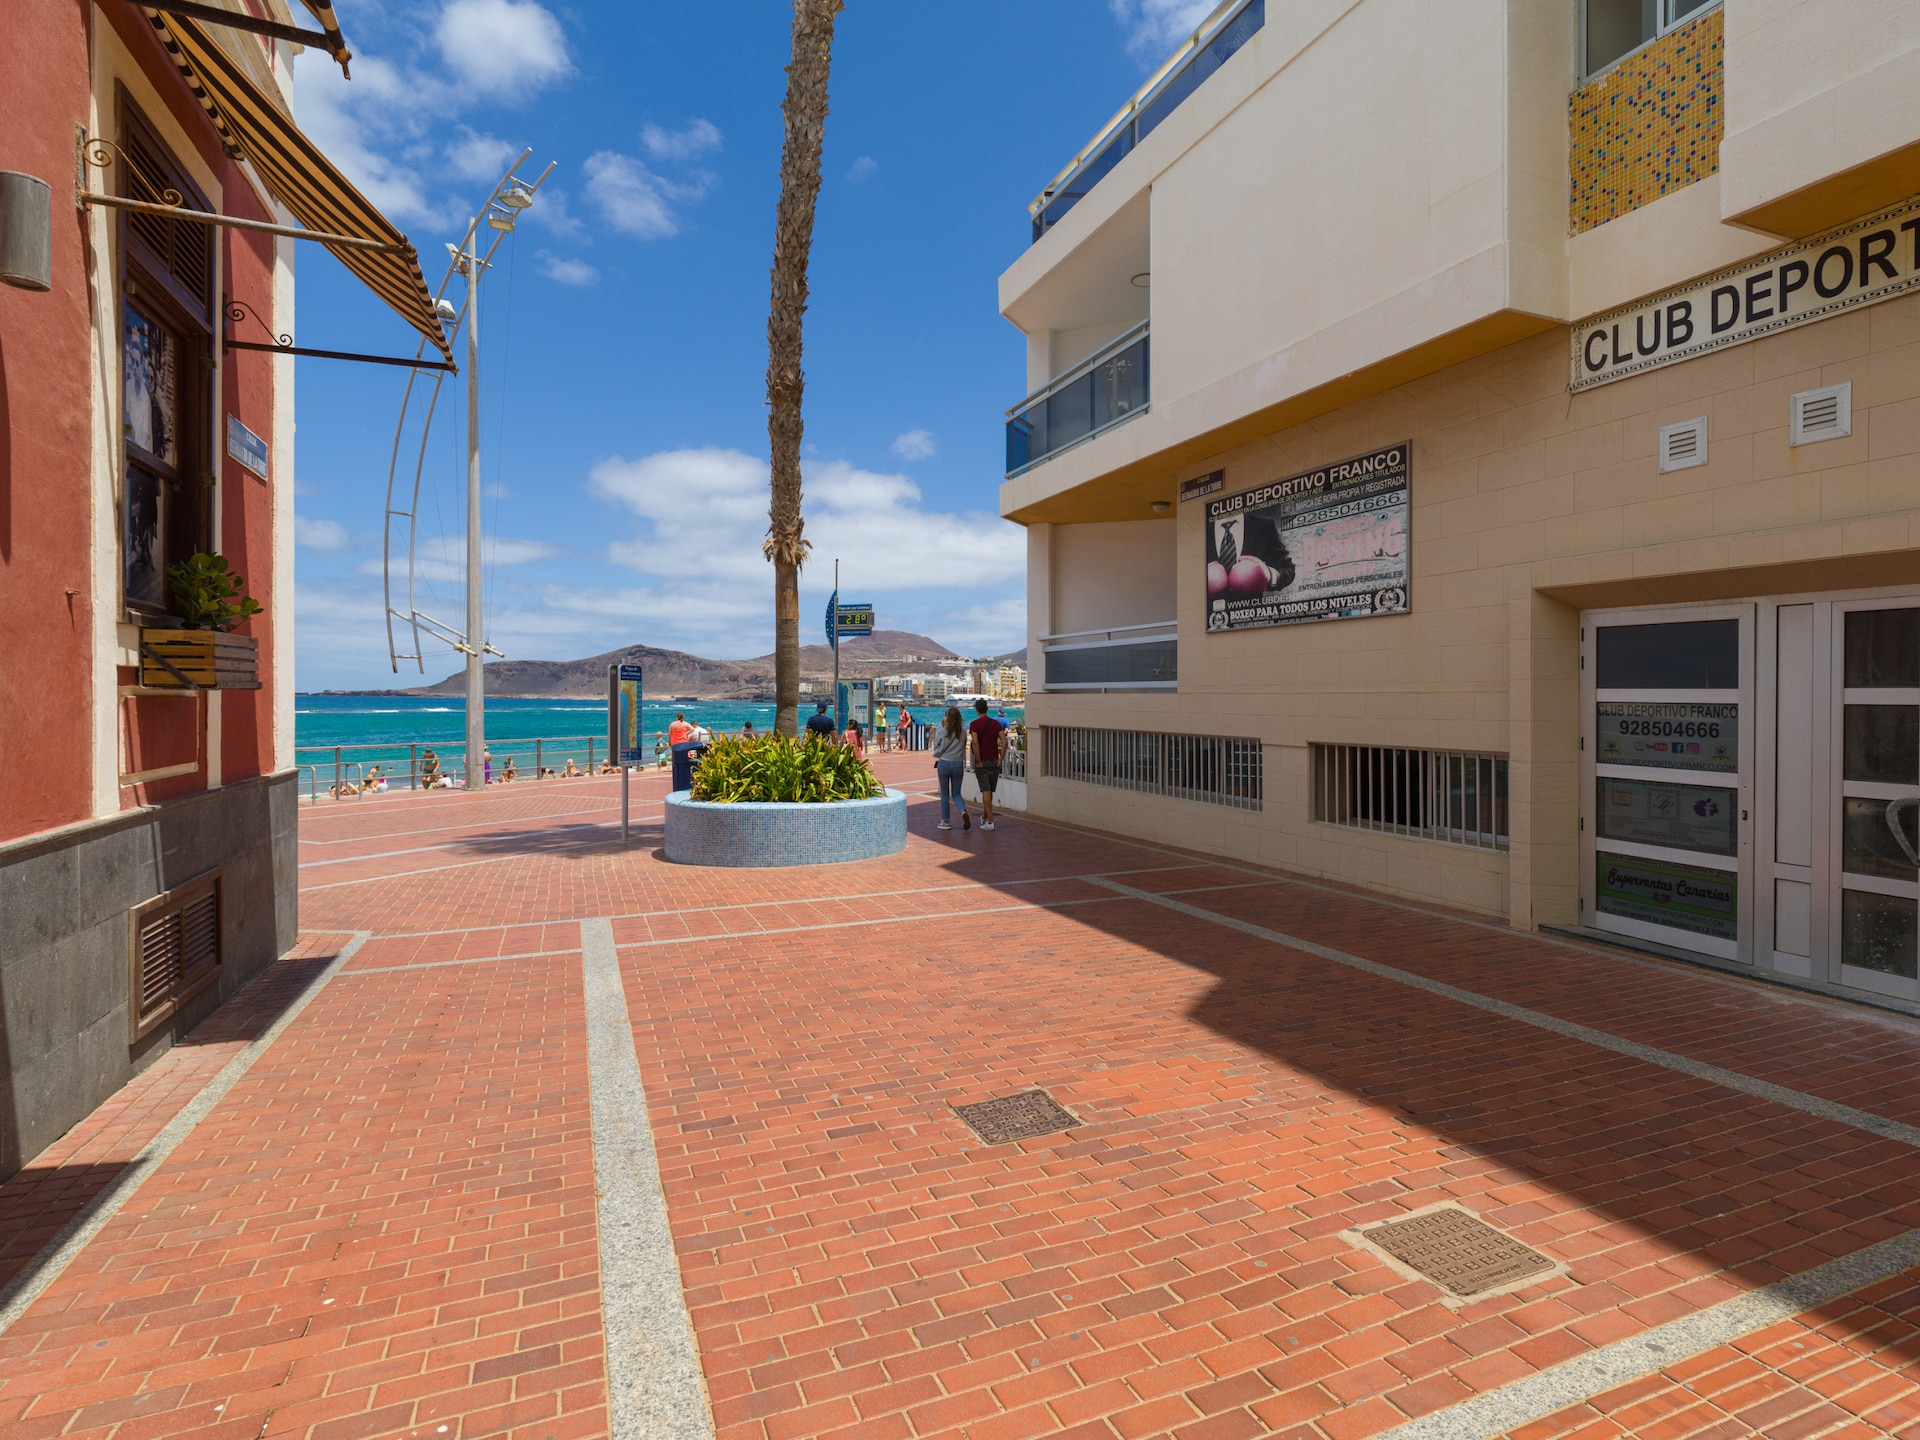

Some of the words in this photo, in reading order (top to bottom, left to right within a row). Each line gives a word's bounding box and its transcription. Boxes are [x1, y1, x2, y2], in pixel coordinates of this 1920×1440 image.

[1584, 300, 1694, 372] CLUB
[1200, 486, 1205, 496] DE
[1205, 484, 1210, 494] LA
[1212, 496, 1243, 516] CLUB
[1246, 472, 1326, 506] DEPORTIVO
[1330, 450, 1400, 483] FRANCO
[1332, 472, 1372, 489] ENTRENADORES
[1375, 465, 1404, 477] TITULADOS
[1296, 498, 1314, 511] MARCA
[1314, 496, 1321, 506] DE
[1322, 492, 1337, 504] ROPA
[1338, 486, 1358, 500] PROPIA
[1365, 474, 1404, 492] REGISTRADA
[1298, 493, 1400, 525] 928504666
[1302, 516, 1402, 573] BOXING
[1298, 577, 1354, 591] ENTRENAMIENTOS
[1356, 571, 1402, 584] PERSONALES
[1230, 609, 1256, 620] BOXEO
[1257, 606, 1278, 617] PARA
[1280, 602, 1310, 614] TODOS
[1310, 599, 1328, 611] LOS
[1329, 594, 1372, 608] NIVELES
[1600, 704, 1624, 716] CLUB
[1627, 705, 1687, 718] DEPORTIVO
[1690, 706, 1738, 720] FRANCO
[1620, 720, 1720, 738] 928504666
[1607, 868, 1672, 891] Superventas
[1676, 880, 1730, 902] Canarias
[1711, 928, 1730, 938] TORRE
